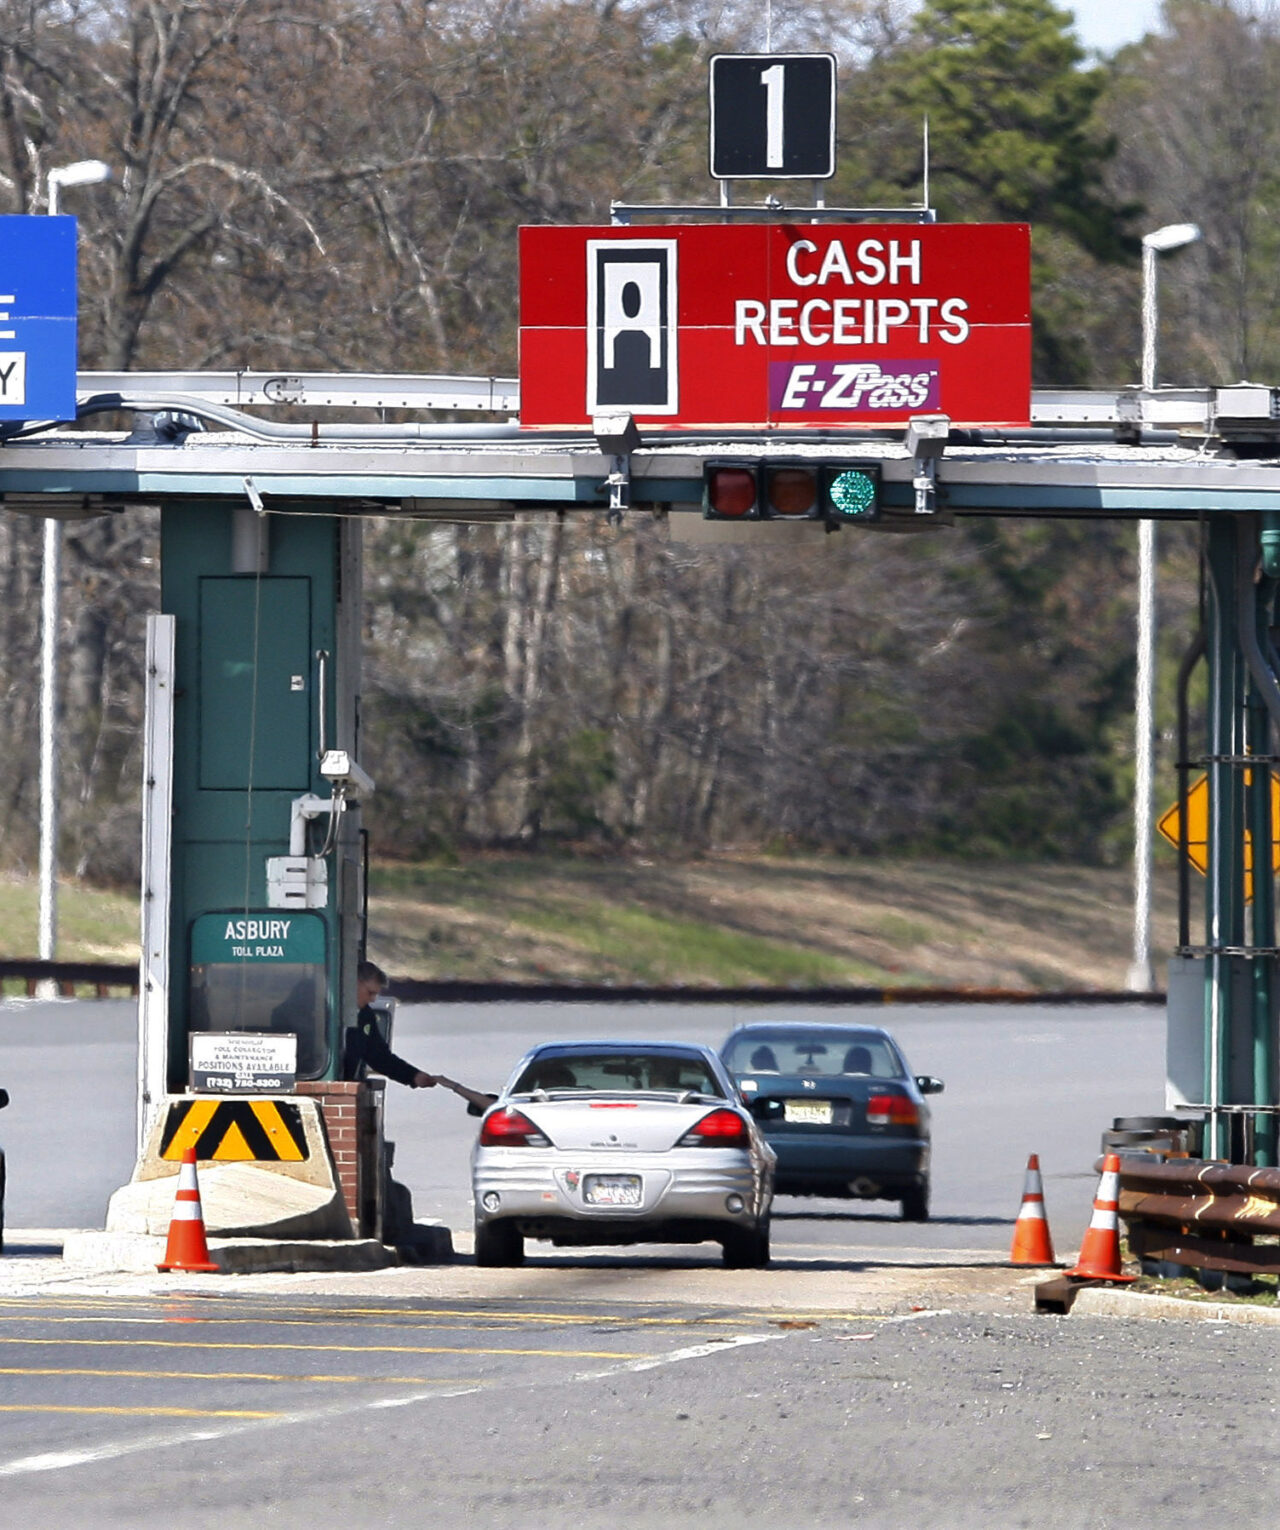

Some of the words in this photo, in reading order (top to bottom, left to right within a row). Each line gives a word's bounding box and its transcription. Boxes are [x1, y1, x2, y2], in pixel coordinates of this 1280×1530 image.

[760, 64, 785, 168] 1
[785, 239, 922, 287] CASH
[734, 297, 970, 345] RECEIPTS
[224, 920, 291, 940] ASBURY
[232, 946, 253, 957] TOLL
[255, 946, 284, 957] PLAZA
[198, 1061, 243, 1071] POSITIONS
